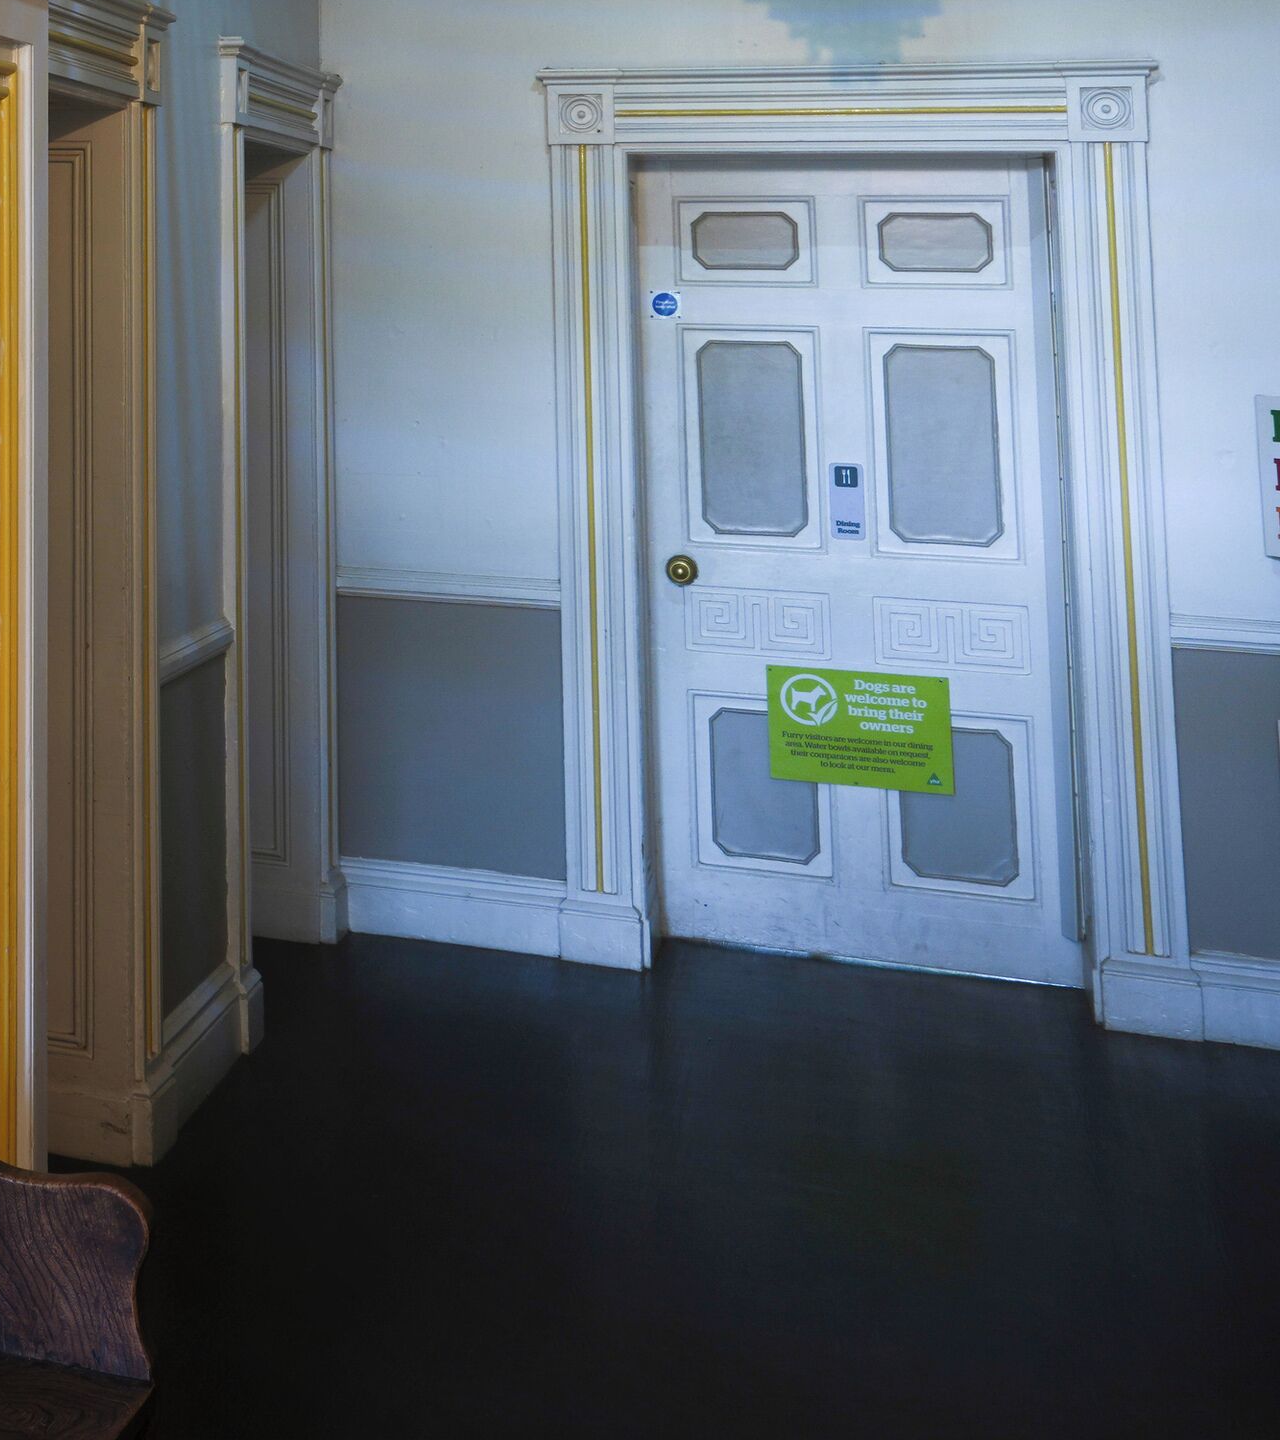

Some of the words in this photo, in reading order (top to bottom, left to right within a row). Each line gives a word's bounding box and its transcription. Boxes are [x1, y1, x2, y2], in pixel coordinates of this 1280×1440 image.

[836, 520, 861, 528] Dining
[854, 679, 890, 694] Dogs
[892, 683, 916, 694] are
[844, 693, 910, 707] welcome
[912, 697, 927, 708] to
[848, 705, 887, 720] bring
[889, 708, 924, 721] their
[860, 721, 914, 734] owners
[782, 731, 804, 740] Furry
[847, 737, 883, 745] welcome
[907, 741, 933, 751] dining
[890, 758, 926, 767] welcome
